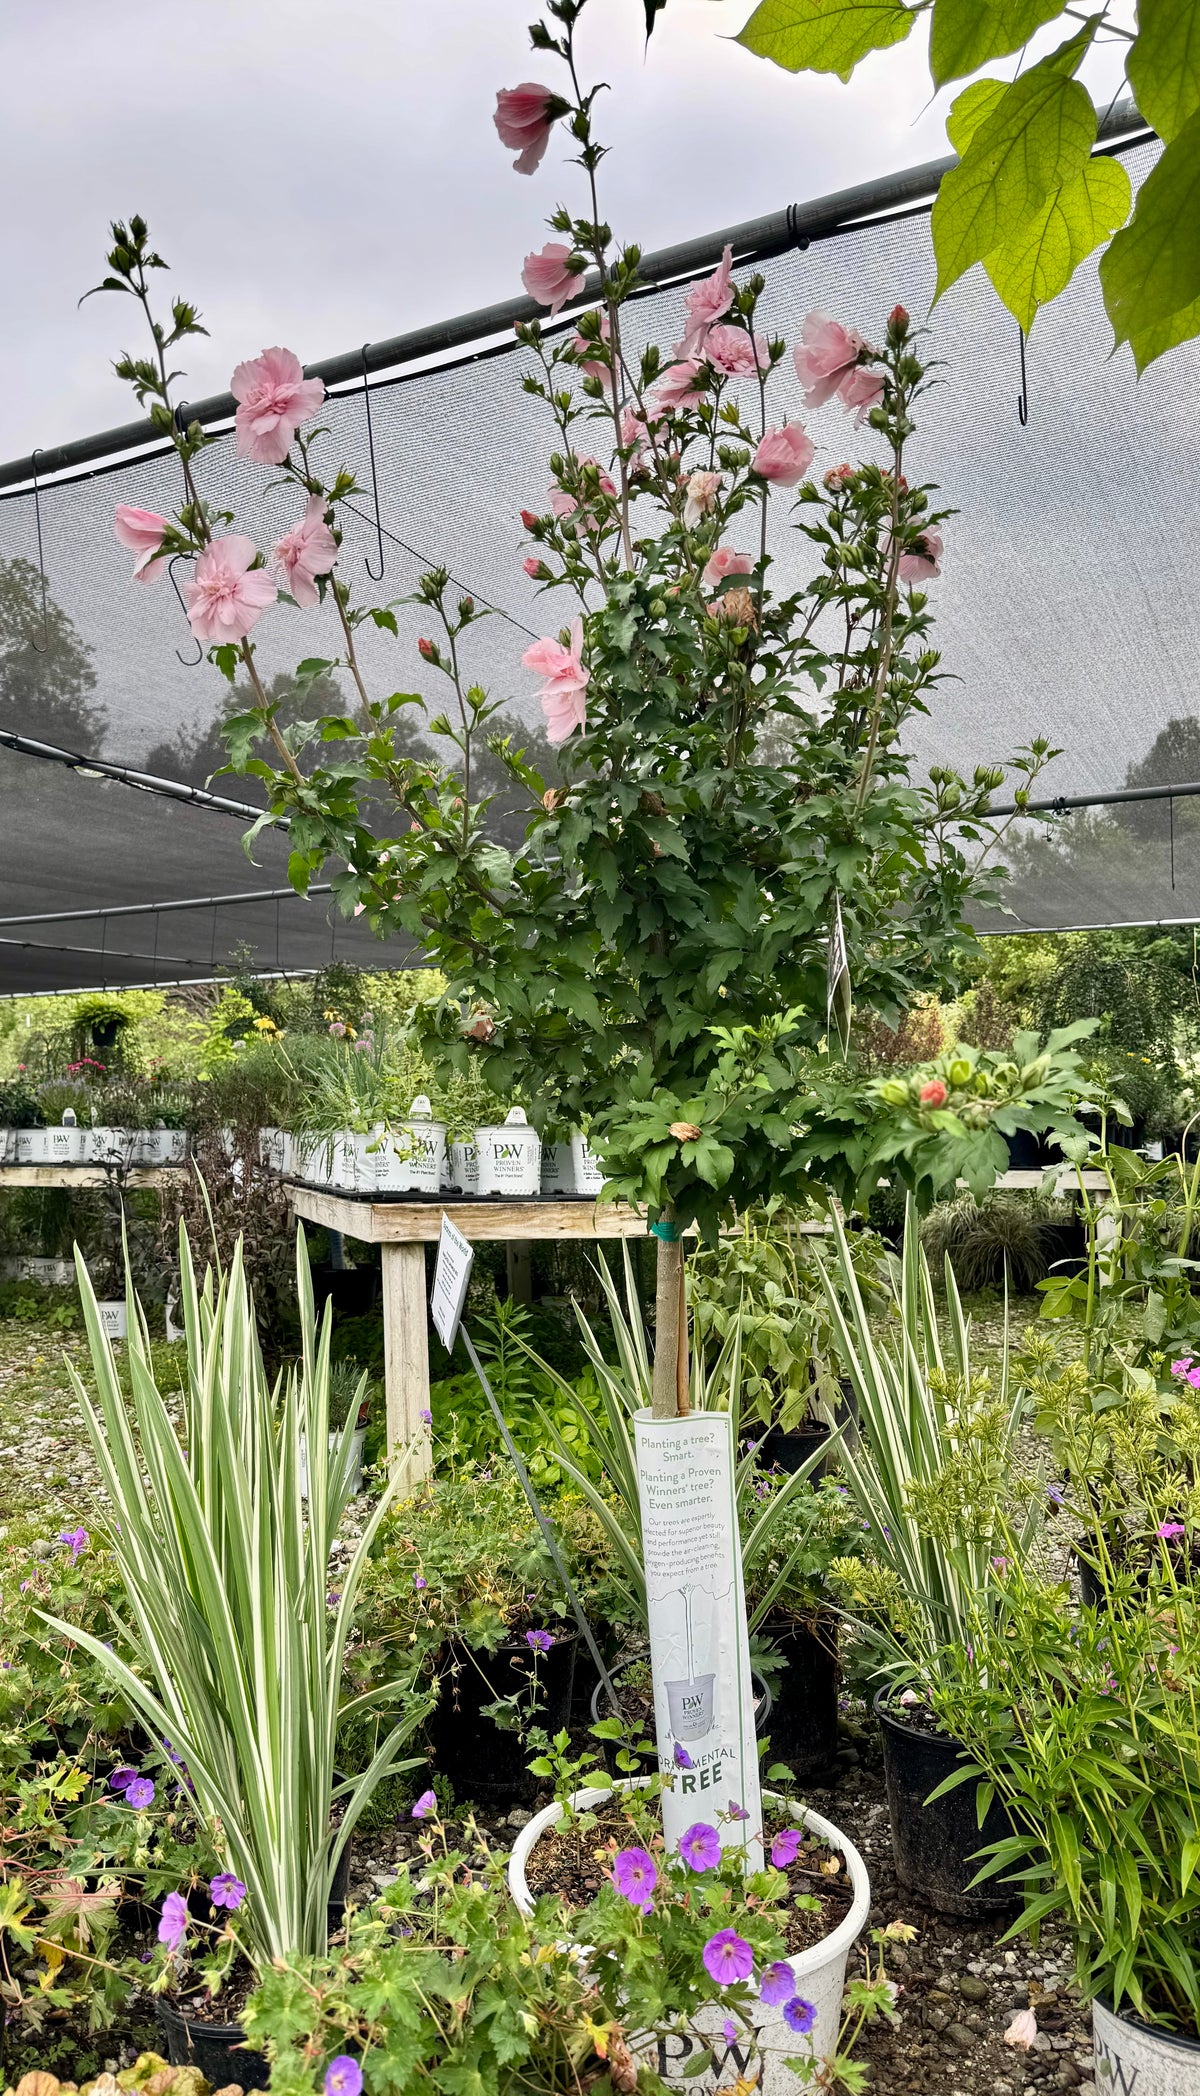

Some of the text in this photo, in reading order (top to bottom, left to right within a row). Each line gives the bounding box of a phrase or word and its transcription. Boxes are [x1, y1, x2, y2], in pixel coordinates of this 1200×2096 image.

[493, 1144, 524, 1159] PW
[641, 1437, 681, 1450] Planting
[691, 1432, 715, 1444] tree?
[663, 1451, 694, 1462] Smart.
[640, 1468, 722, 1484] Planting a Proven
[690, 1478, 714, 1491] tree?
[649, 1496, 713, 1510] Even smarter.
[648, 1518, 661, 1526] Our
[691, 1512, 716, 1522] expertly
[668, 1528, 678, 1536] for
[679, 1525, 702, 1536] superior
[704, 1522, 726, 1531] beauty
[658, 1536, 698, 1549] performance
[699, 1533, 708, 1542] yet
[648, 1549, 670, 1558] provide
[700, 1551, 726, 1561] benefits
[662, 1570, 684, 1579] expect
[686, 1566, 700, 1575] from
[681, 1692, 704, 1710] PW
[666, 1761, 722, 1794] TREE
[656, 2025, 766, 2080] PW
